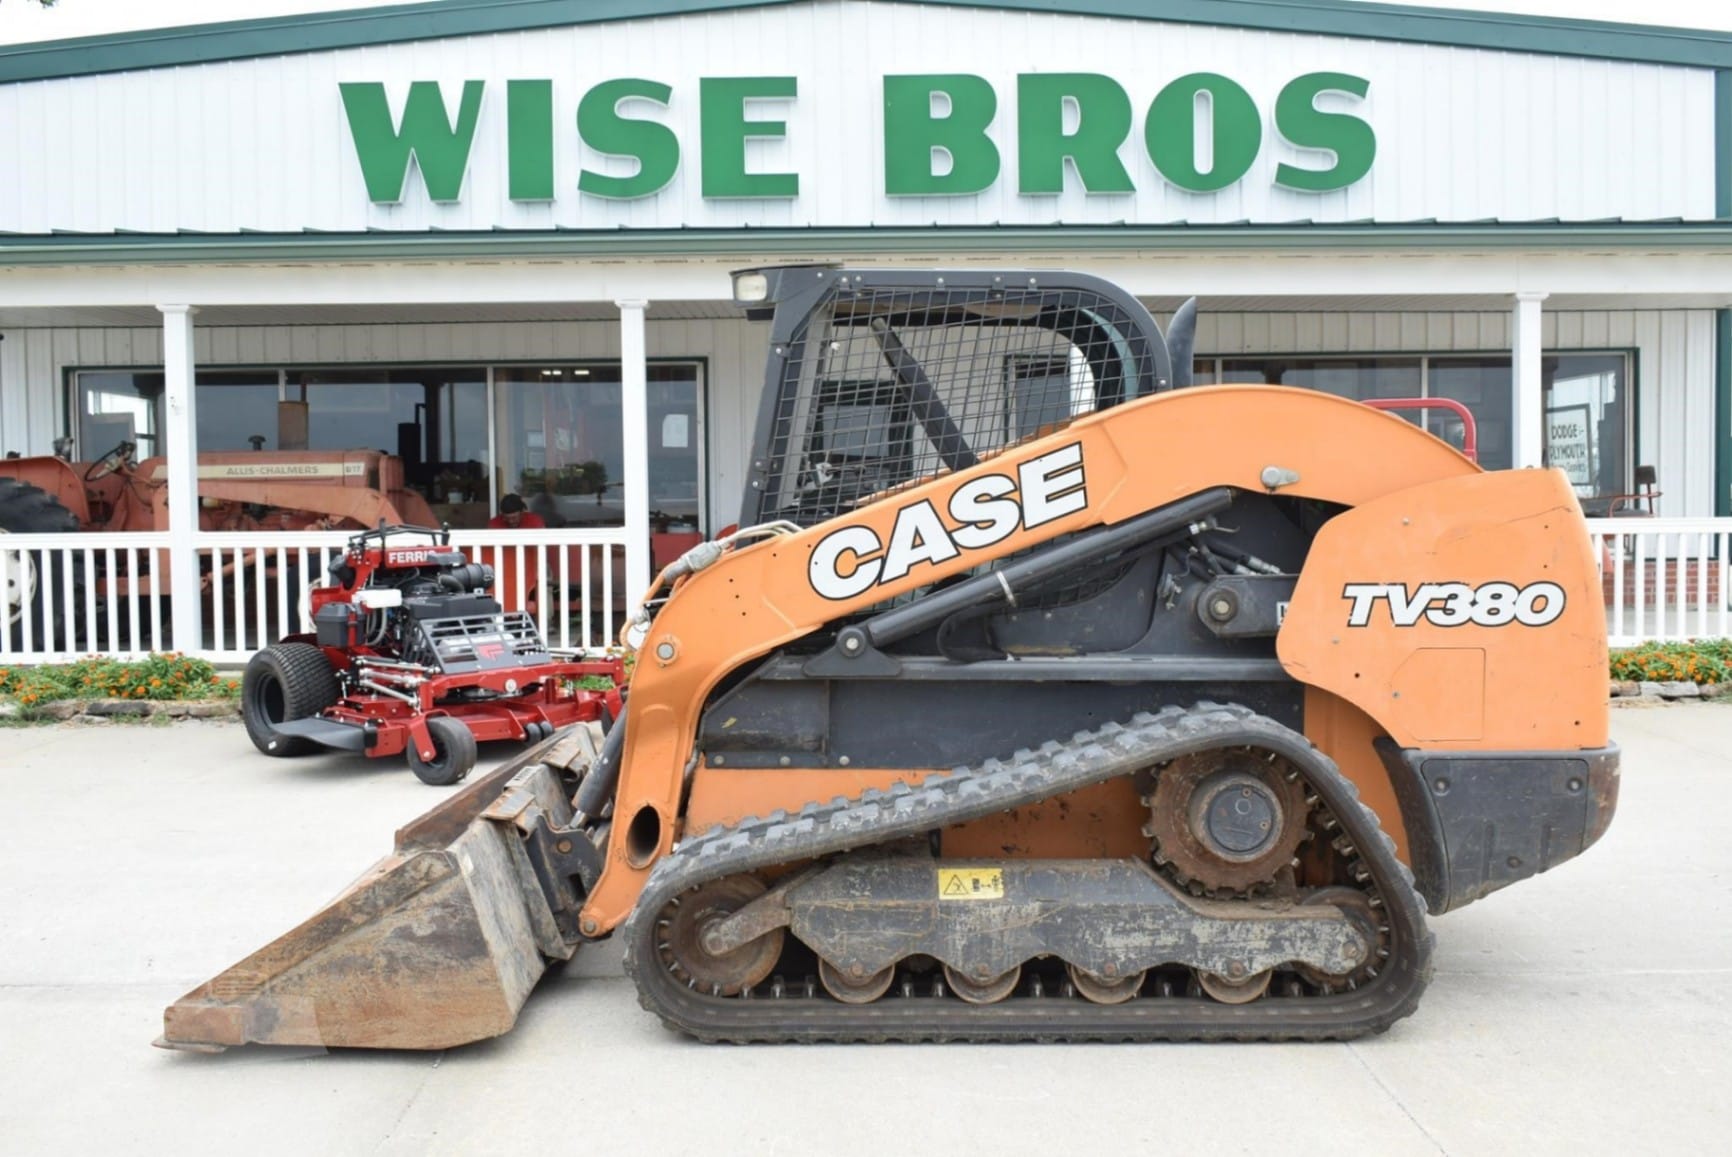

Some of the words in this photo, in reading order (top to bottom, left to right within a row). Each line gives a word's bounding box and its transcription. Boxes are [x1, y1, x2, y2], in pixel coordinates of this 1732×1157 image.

[338, 75, 800, 204] WISE
[883, 71, 1377, 195] BROS
[226, 465, 319, 475] ALLIS-CHALMERS
[808, 441, 1088, 600] CASE
[1342, 581, 1567, 628] TV380
